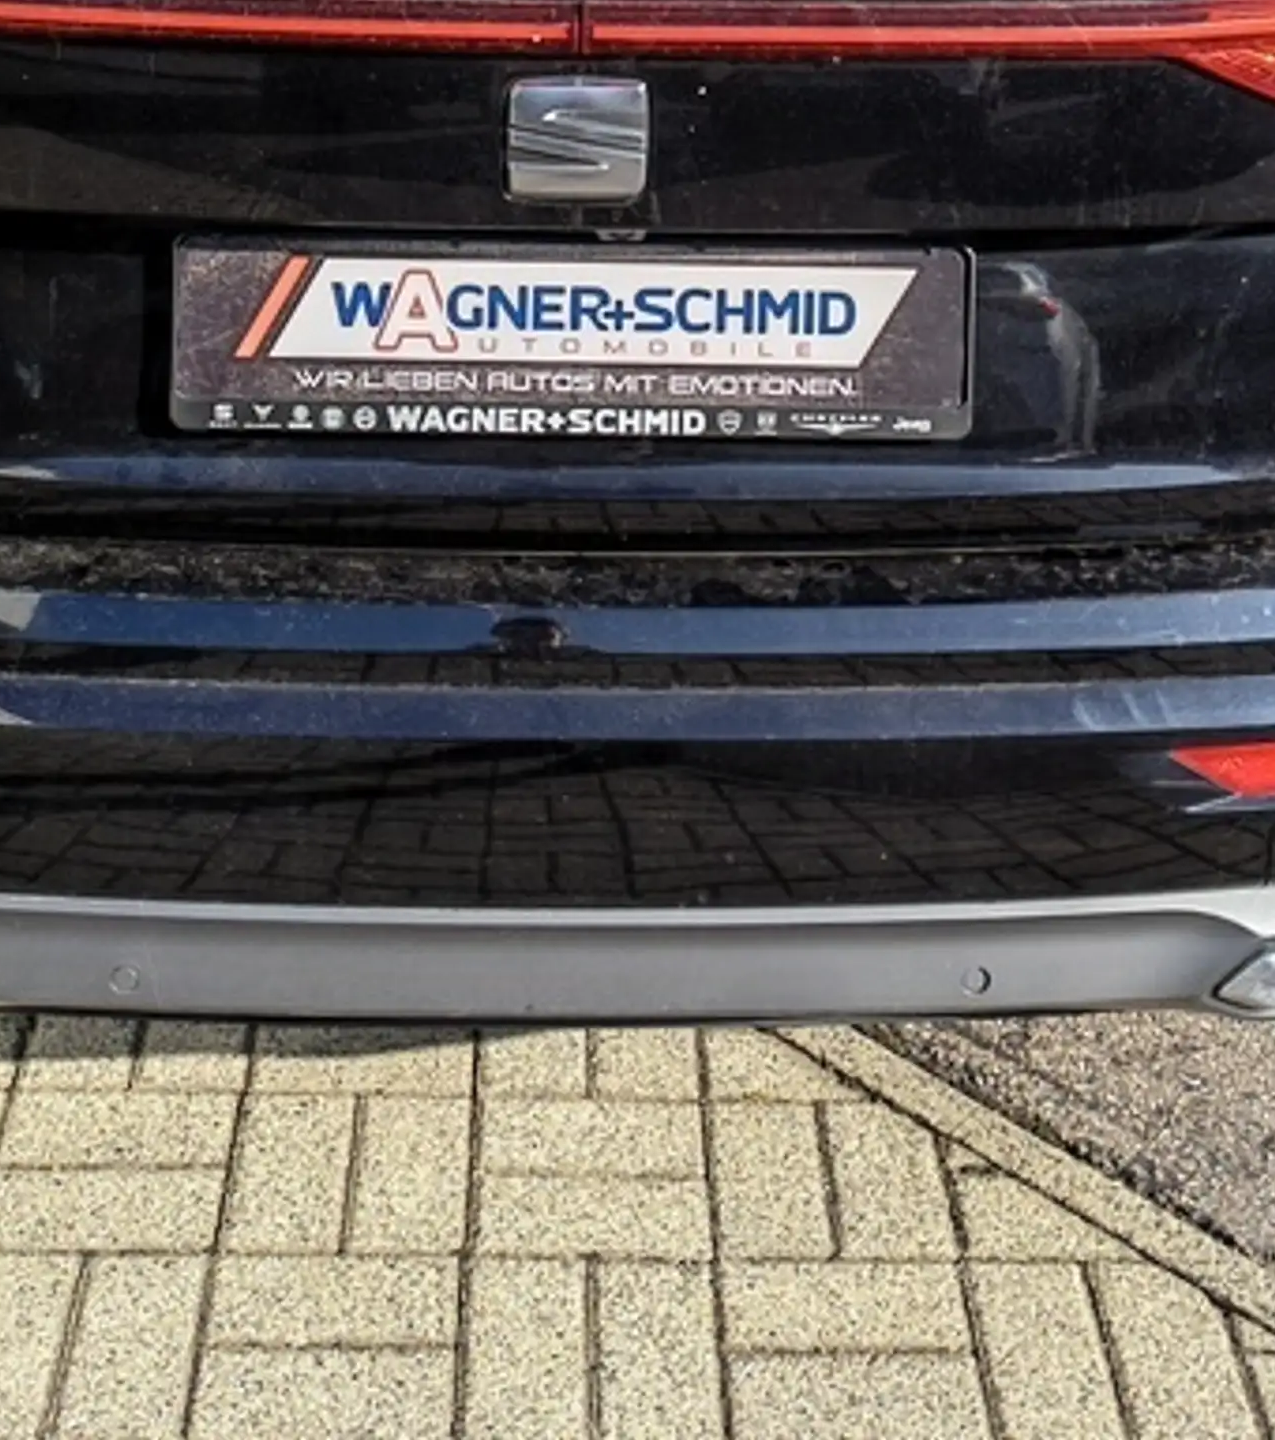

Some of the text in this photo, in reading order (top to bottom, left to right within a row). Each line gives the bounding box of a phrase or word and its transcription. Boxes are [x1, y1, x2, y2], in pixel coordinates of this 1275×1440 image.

[330, 268, 857, 352] WAGNER+SCHMID
[294, 370, 355, 389] WIR
[362, 370, 478, 391] LIEBEN
[487, 371, 595, 393] AUTOS
[604, 373, 658, 394] MIT
[386, 406, 706, 435] WAGNER+SCHMID
